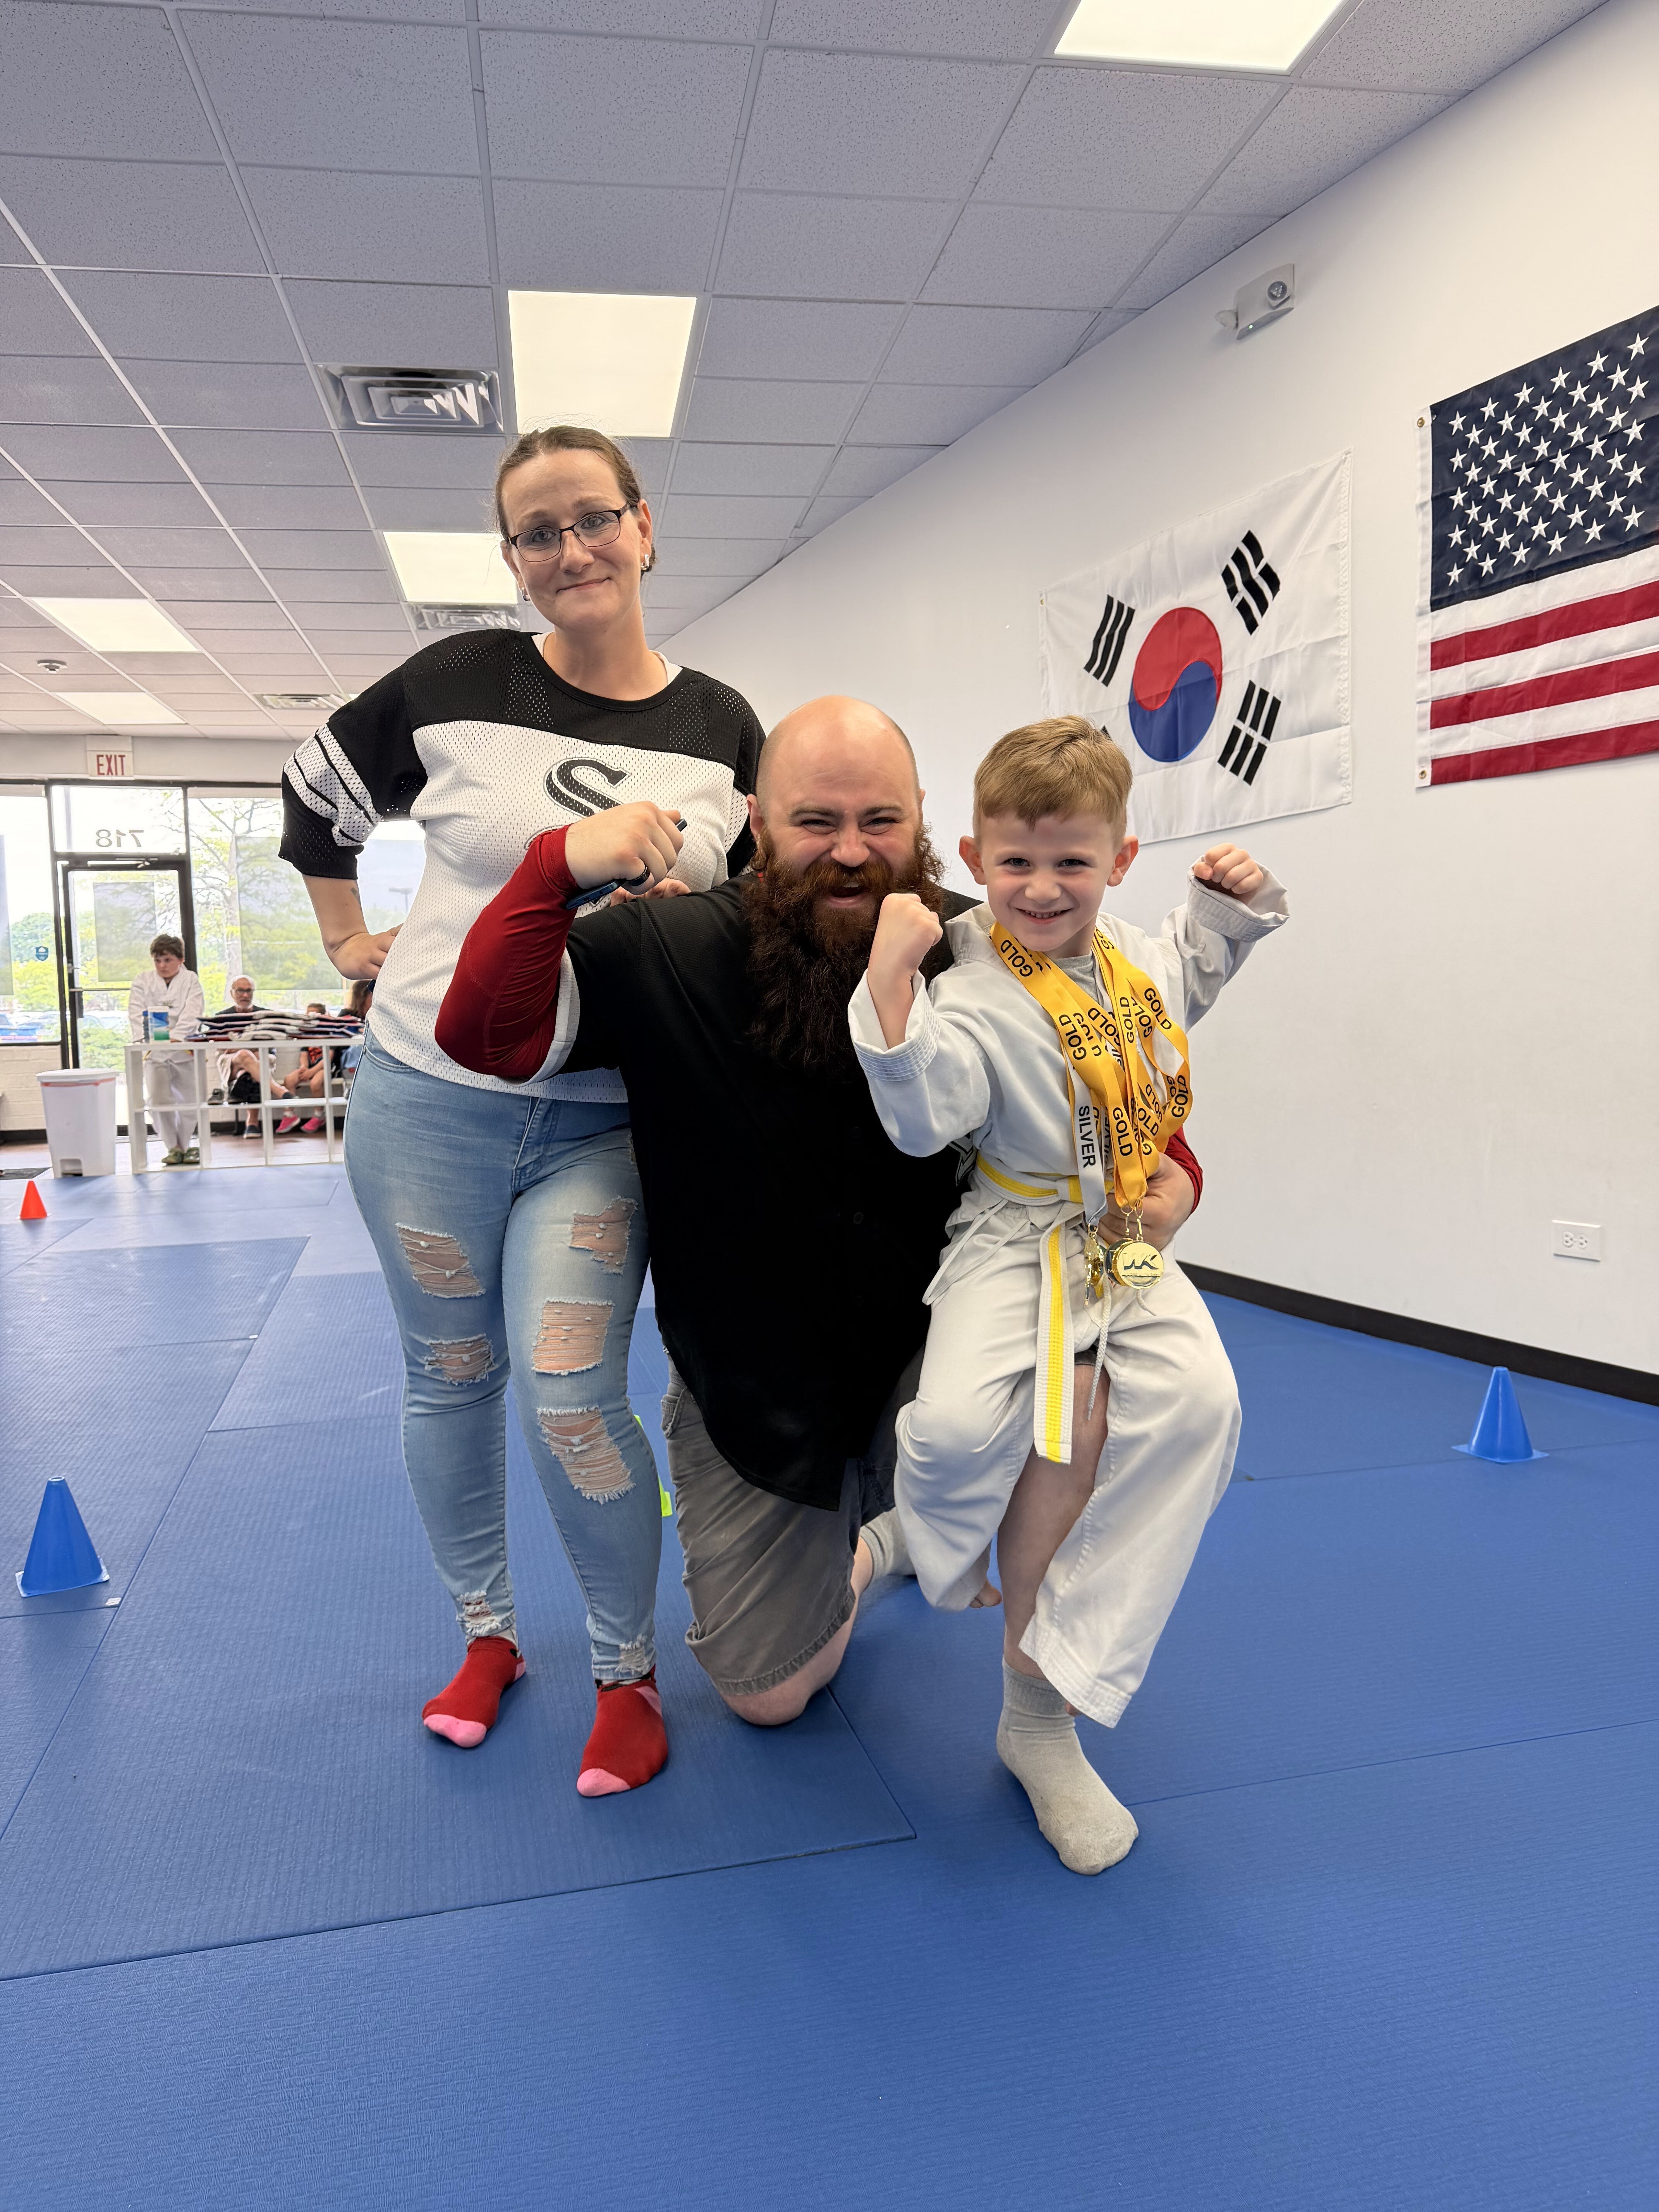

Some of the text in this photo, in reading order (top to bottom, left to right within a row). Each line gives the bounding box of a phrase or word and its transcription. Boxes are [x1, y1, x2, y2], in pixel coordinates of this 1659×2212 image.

[96, 754, 126, 775] EXIT
[1000, 939, 1033, 977] GOLD
[1120, 996, 1134, 1044] GOLD
[1144, 988, 1172, 1030] GOLD
[1059, 1014, 1087, 1060] GOLD
[1171, 1075, 1188, 1118] GOLD
[1079, 1105, 1096, 1168] SILVER
[1113, 1107, 1133, 1156] GOLD
[1138, 1108, 1159, 1136] OLD
